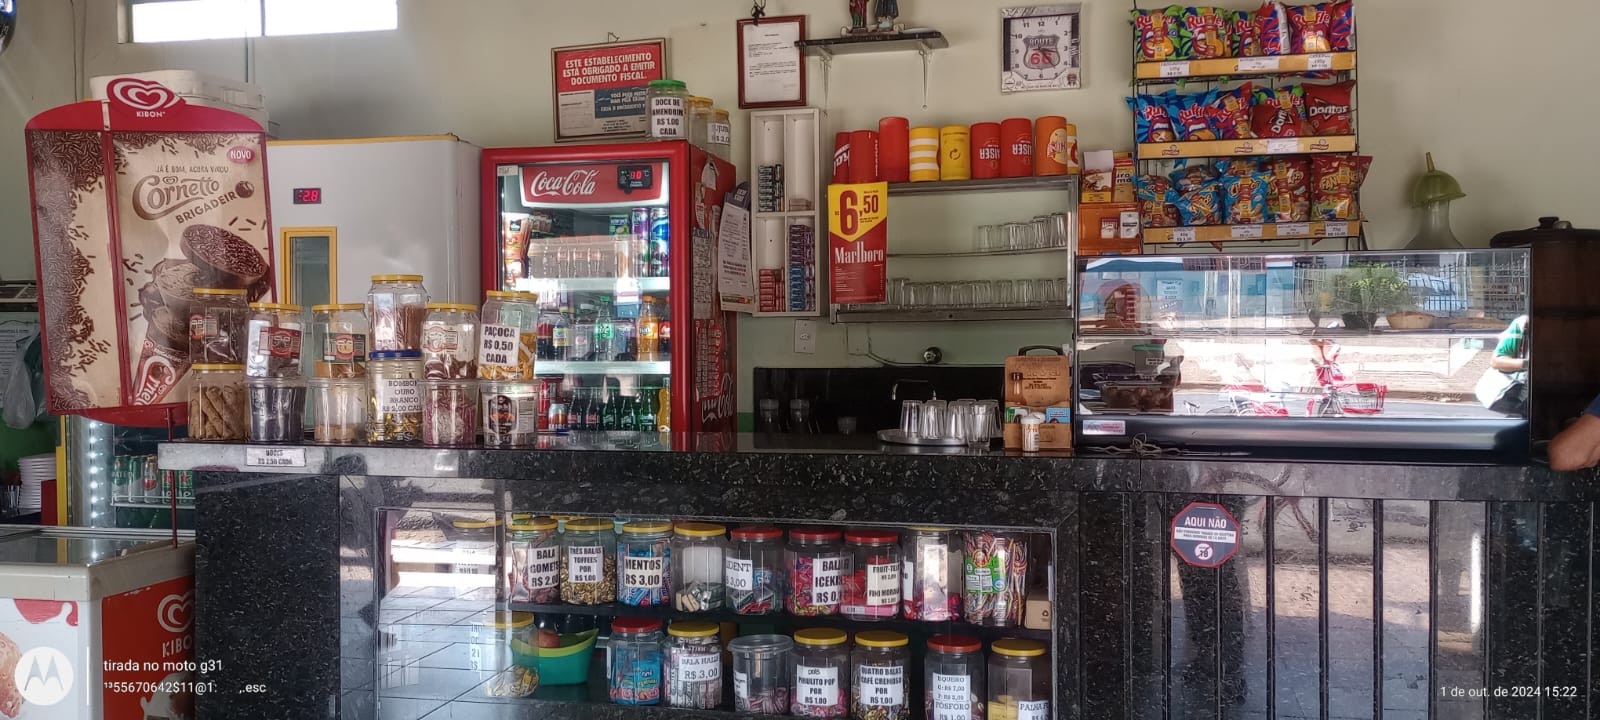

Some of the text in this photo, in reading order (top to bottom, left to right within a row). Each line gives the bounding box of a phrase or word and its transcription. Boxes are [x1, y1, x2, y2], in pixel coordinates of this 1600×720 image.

[565, 52, 652, 68] ESTE ESTABELECIMENTO
[581, 65, 620, 75] OBRIGADO
[622, 64, 629, 72] A
[631, 60, 656, 70] EMITIR
[571, 75, 617, 86] DOCUMENTO
[655, 98, 670, 107] DOCE
[672, 98, 681, 107] DE
[136, 110, 162, 118] KIBON
[1309, 105, 1349, 118] Doritos
[230, 151, 251, 160] NOVO
[530, 168, 600, 198] Coca-Cola
[132, 175, 221, 221] Cornetto
[834, 241, 884, 264] Marlboro
[484, 325, 516, 340] PAÇOCA
[486, 353, 508, 364] CADA
[1184, 515, 1227, 529] AQUI NÃO
[536, 550, 556, 560] BALA
[625, 558, 661, 570] MENTOS
[161, 635, 194, 659] KIBO
[684, 671, 697, 680] R$
[824, 678, 836, 686] POP
